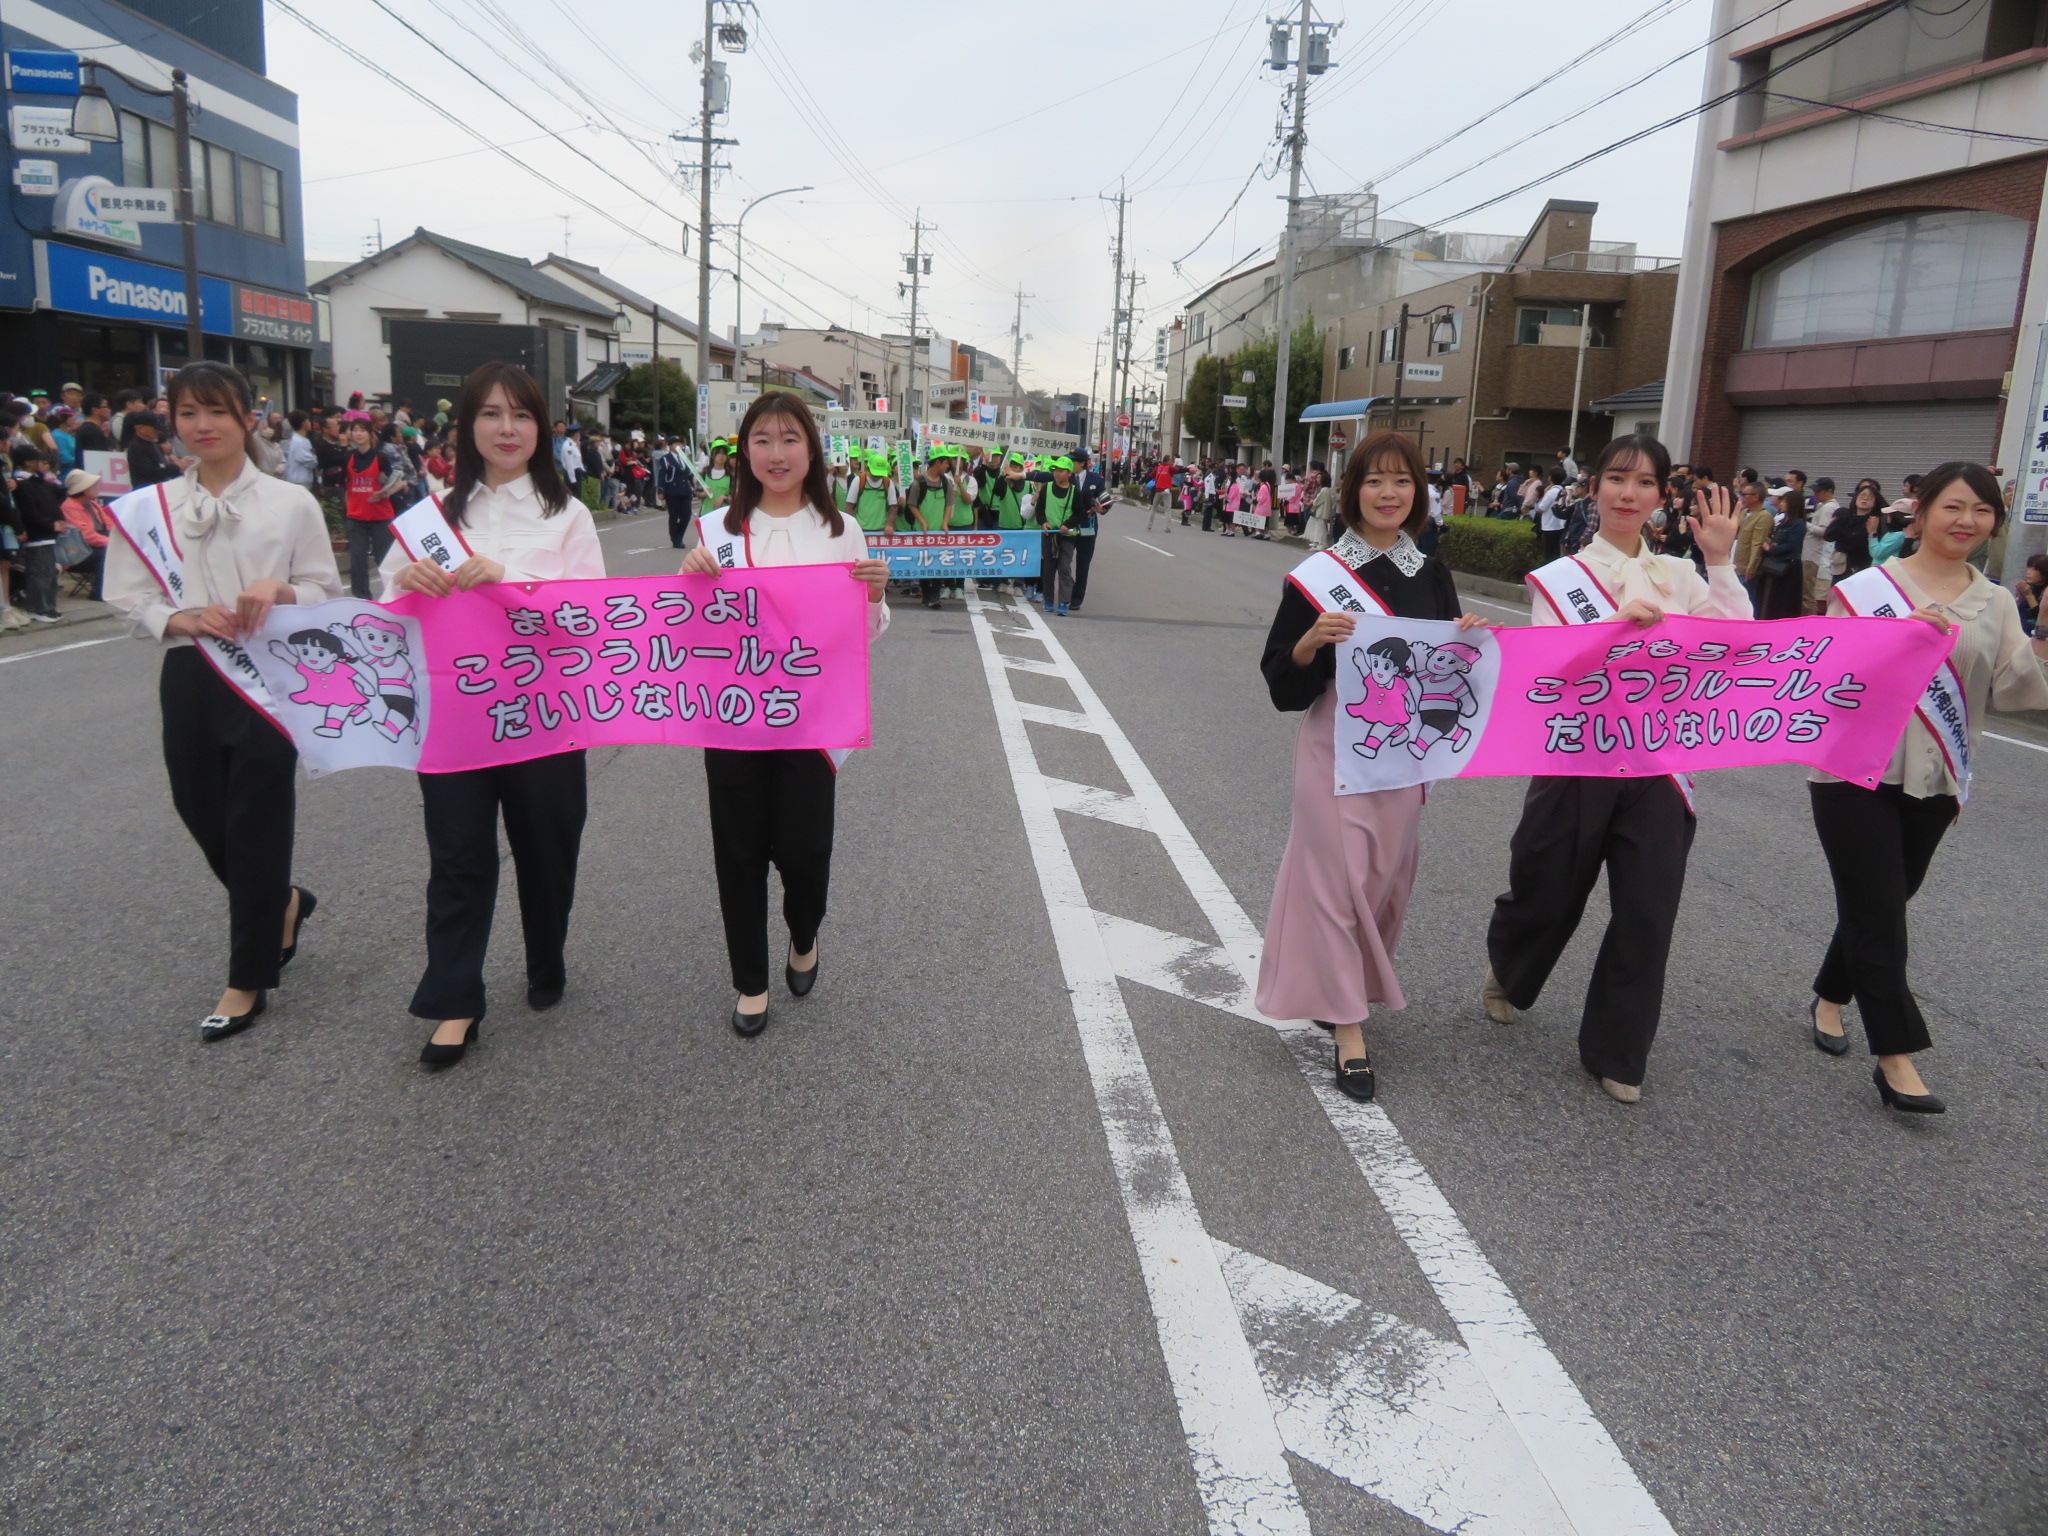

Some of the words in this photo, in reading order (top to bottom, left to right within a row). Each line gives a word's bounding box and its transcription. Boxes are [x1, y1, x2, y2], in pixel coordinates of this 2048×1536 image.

[11, 65, 74, 80] Panasonic
[88, 265, 204, 317] Panason
[831, 420, 897, 430] 山中学区交通少年団
[931, 423, 996, 442] 美合学区交通少年団
[898, 442, 911, 487] 交通安全
[868, 534, 997, 547] 横断歩道をわたりましょう
[503, 586, 758, 637] まもろうよ!
[1567, 588, 1600, 623] 岡崎
[453, 634, 822, 695] こうつうルールと
[1525, 665, 1868, 709] こうつうルールと
[486, 680, 801, 742] だいじないのち
[1544, 706, 1829, 753] だいじないのち
